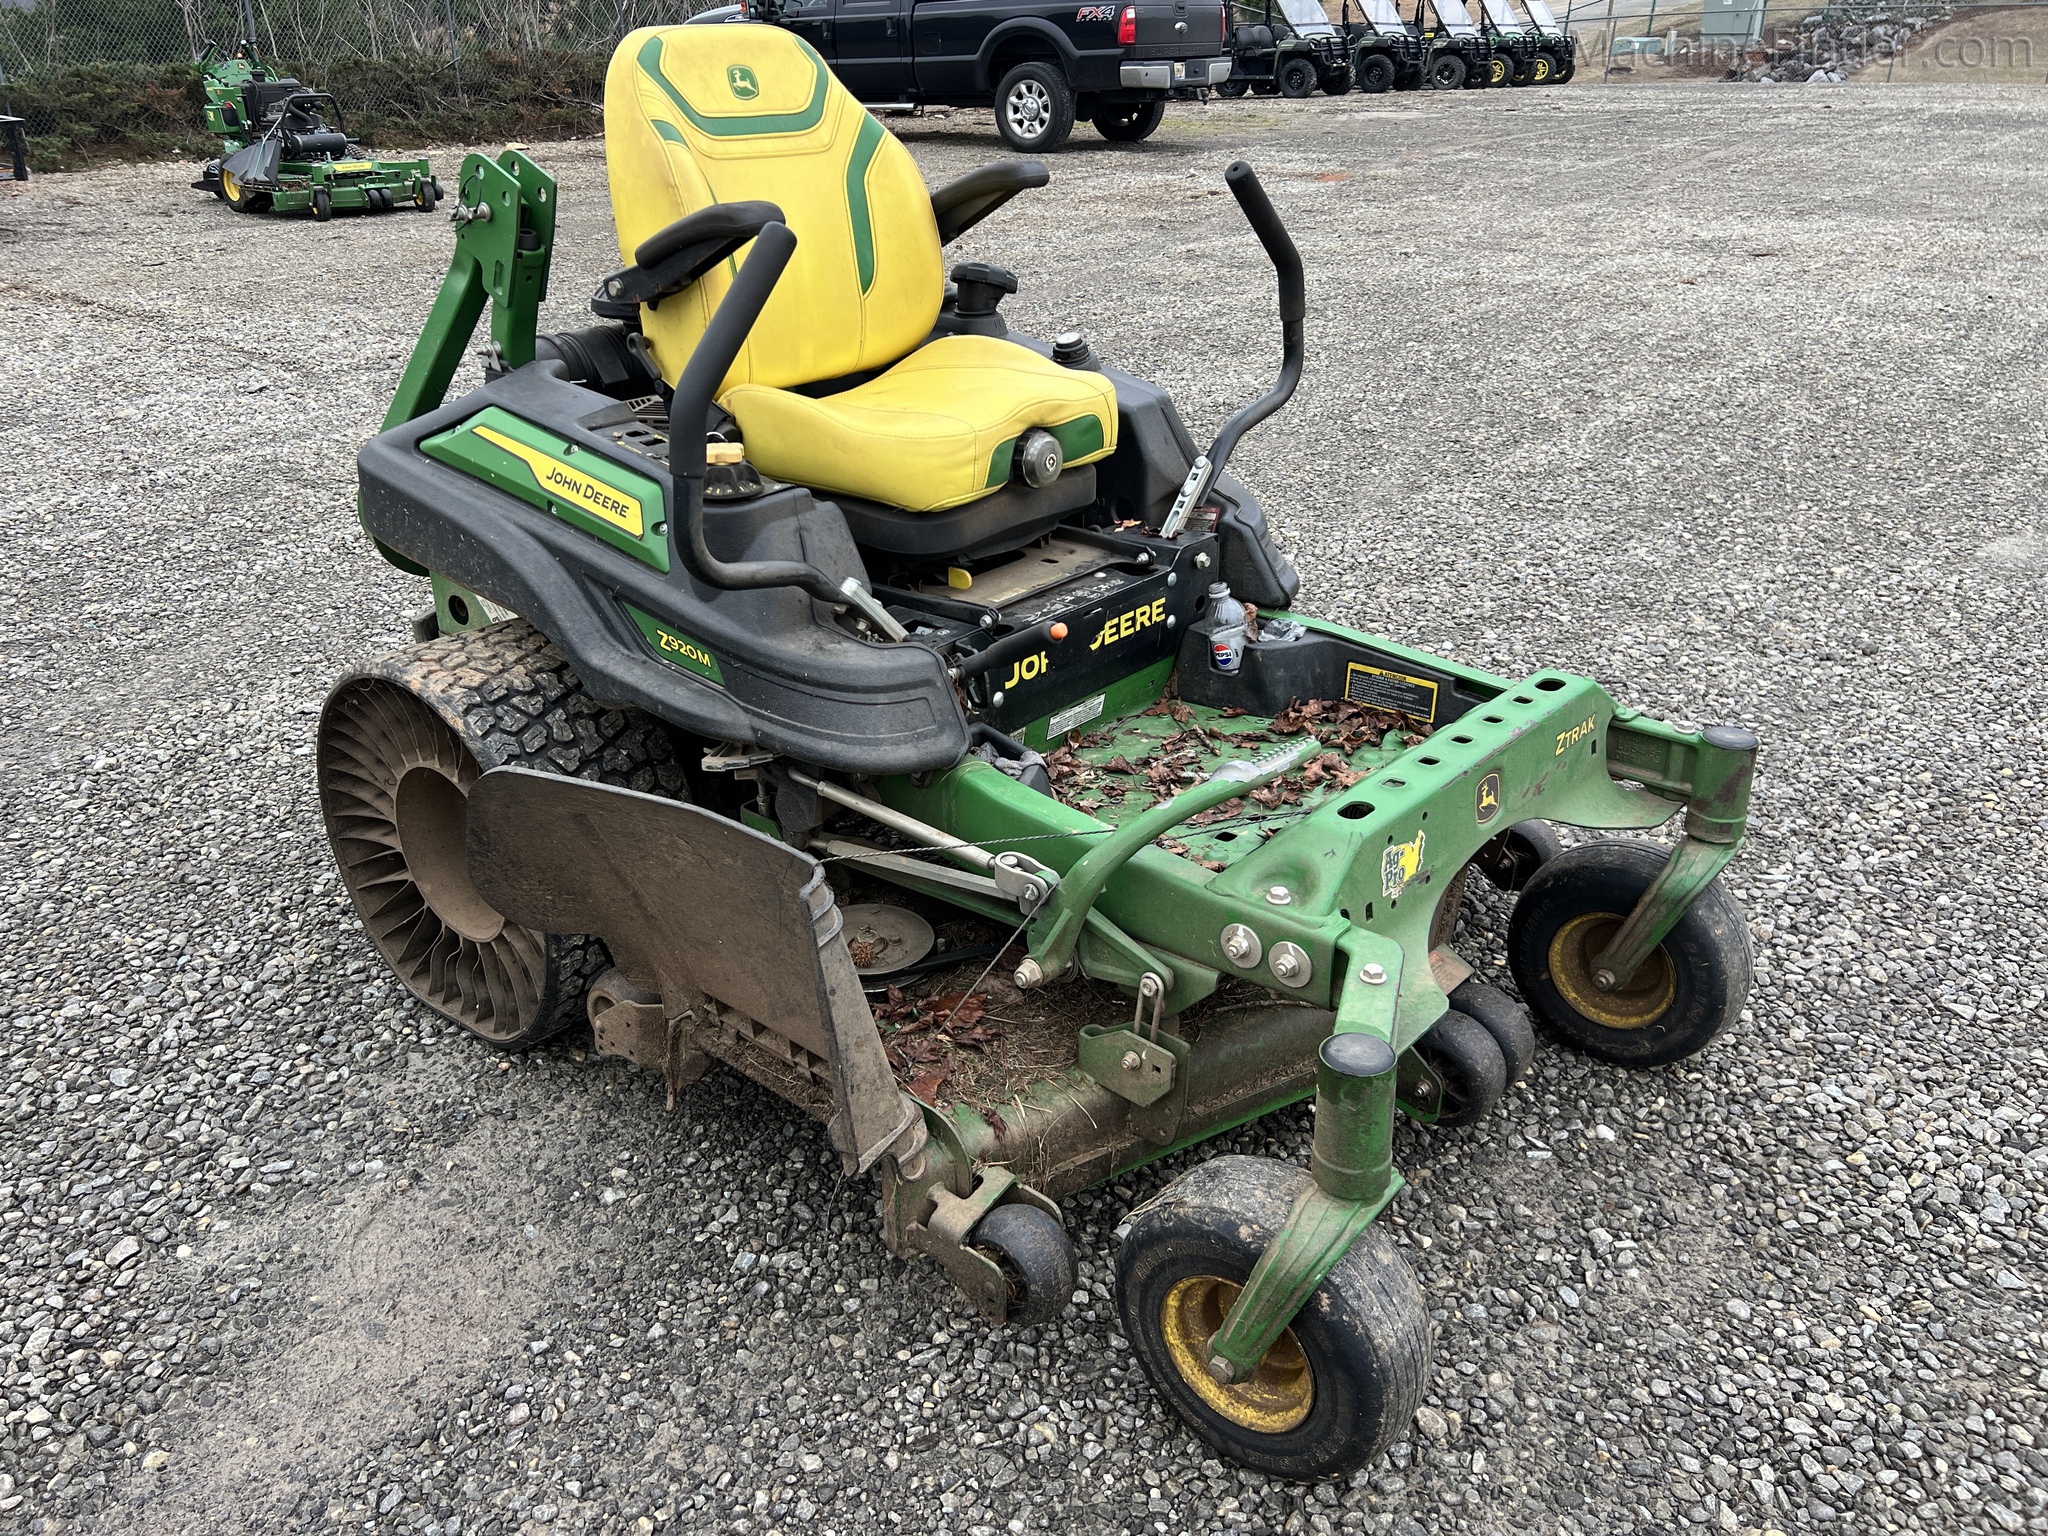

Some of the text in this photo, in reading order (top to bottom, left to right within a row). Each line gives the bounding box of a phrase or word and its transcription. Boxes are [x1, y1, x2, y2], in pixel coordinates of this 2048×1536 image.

[1076, 5, 1116, 19] FX4
[1151, 46, 1180, 56] SUPER
[546, 467, 629, 518] JOHN DEERE
[656, 628, 712, 668] Z920M
[1555, 713, 1597, 757] ZTRAK
[1385, 849, 1405, 873] Ag-
[1385, 866, 1405, 892] Pro
[1134, 1237, 1244, 1282] RELIANCE
[1246, 1426, 1351, 1471] CARLISLE
